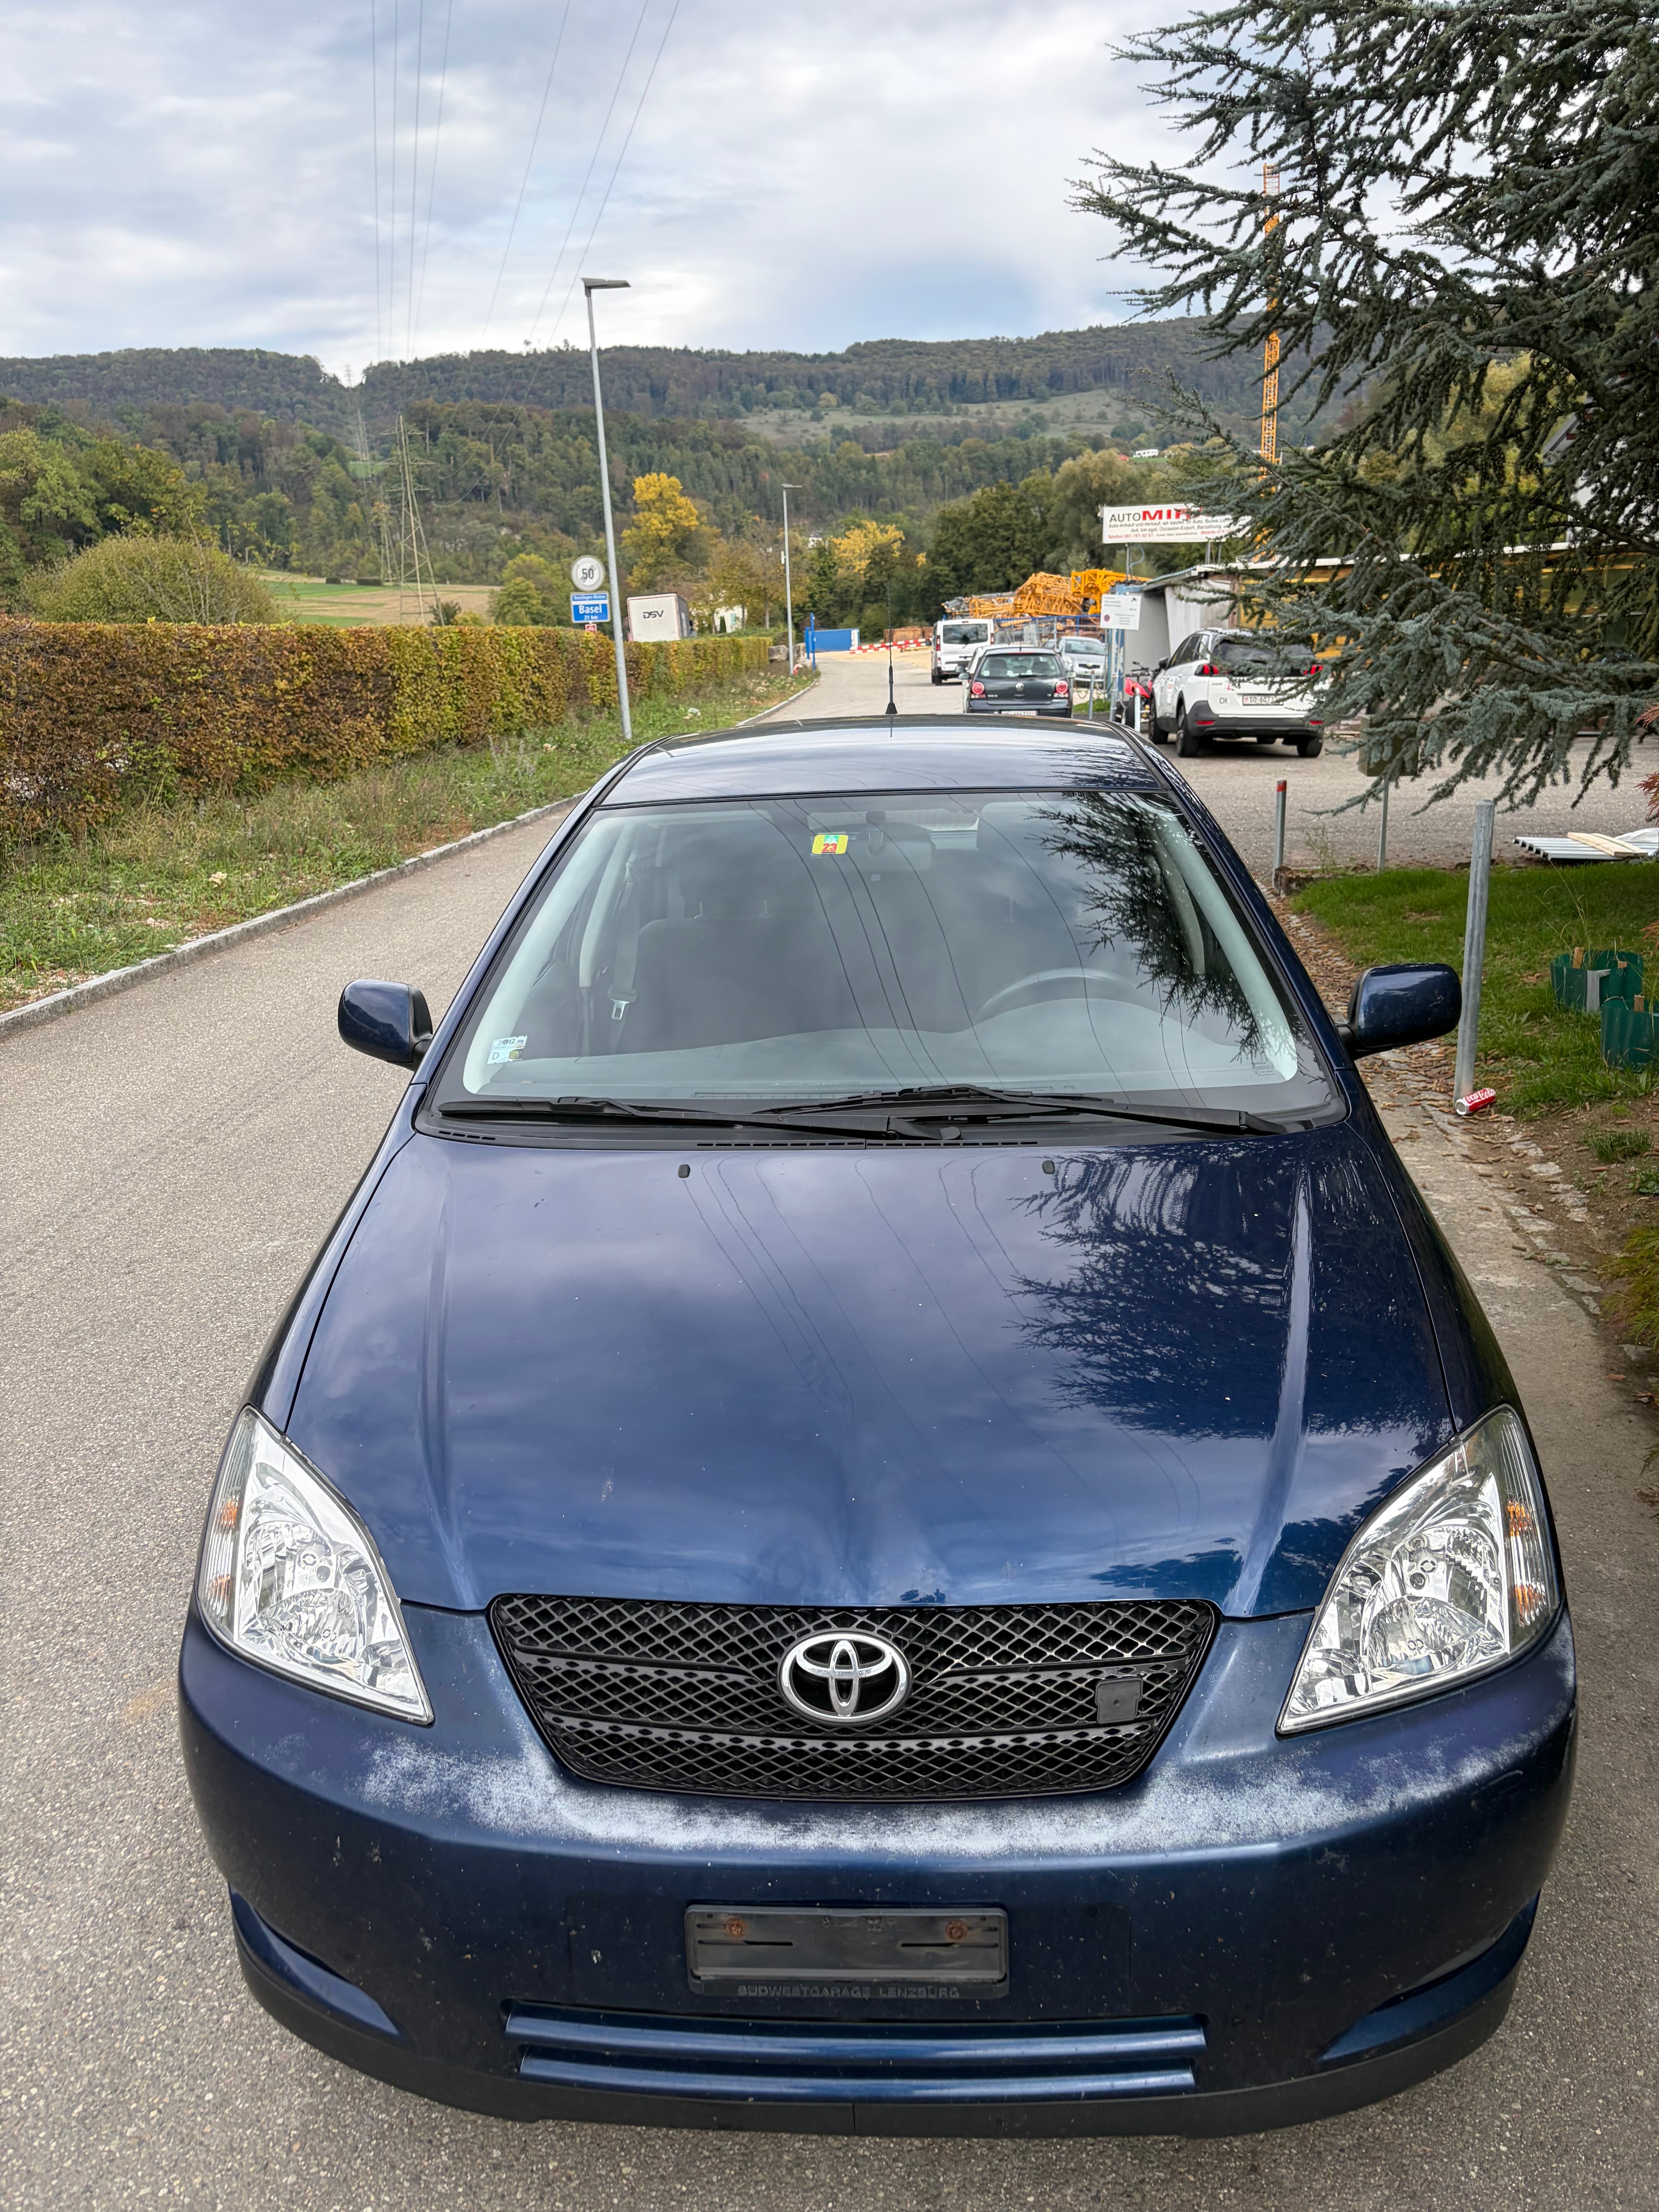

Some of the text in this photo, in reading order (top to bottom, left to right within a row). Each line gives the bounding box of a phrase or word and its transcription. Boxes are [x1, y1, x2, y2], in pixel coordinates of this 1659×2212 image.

[582, 568, 594, 579] 50
[579, 604, 602, 614] Basel
[643, 610, 664, 619] DSV
[821, 843, 837, 852] 23
[491, 1052, 500, 1060] D
